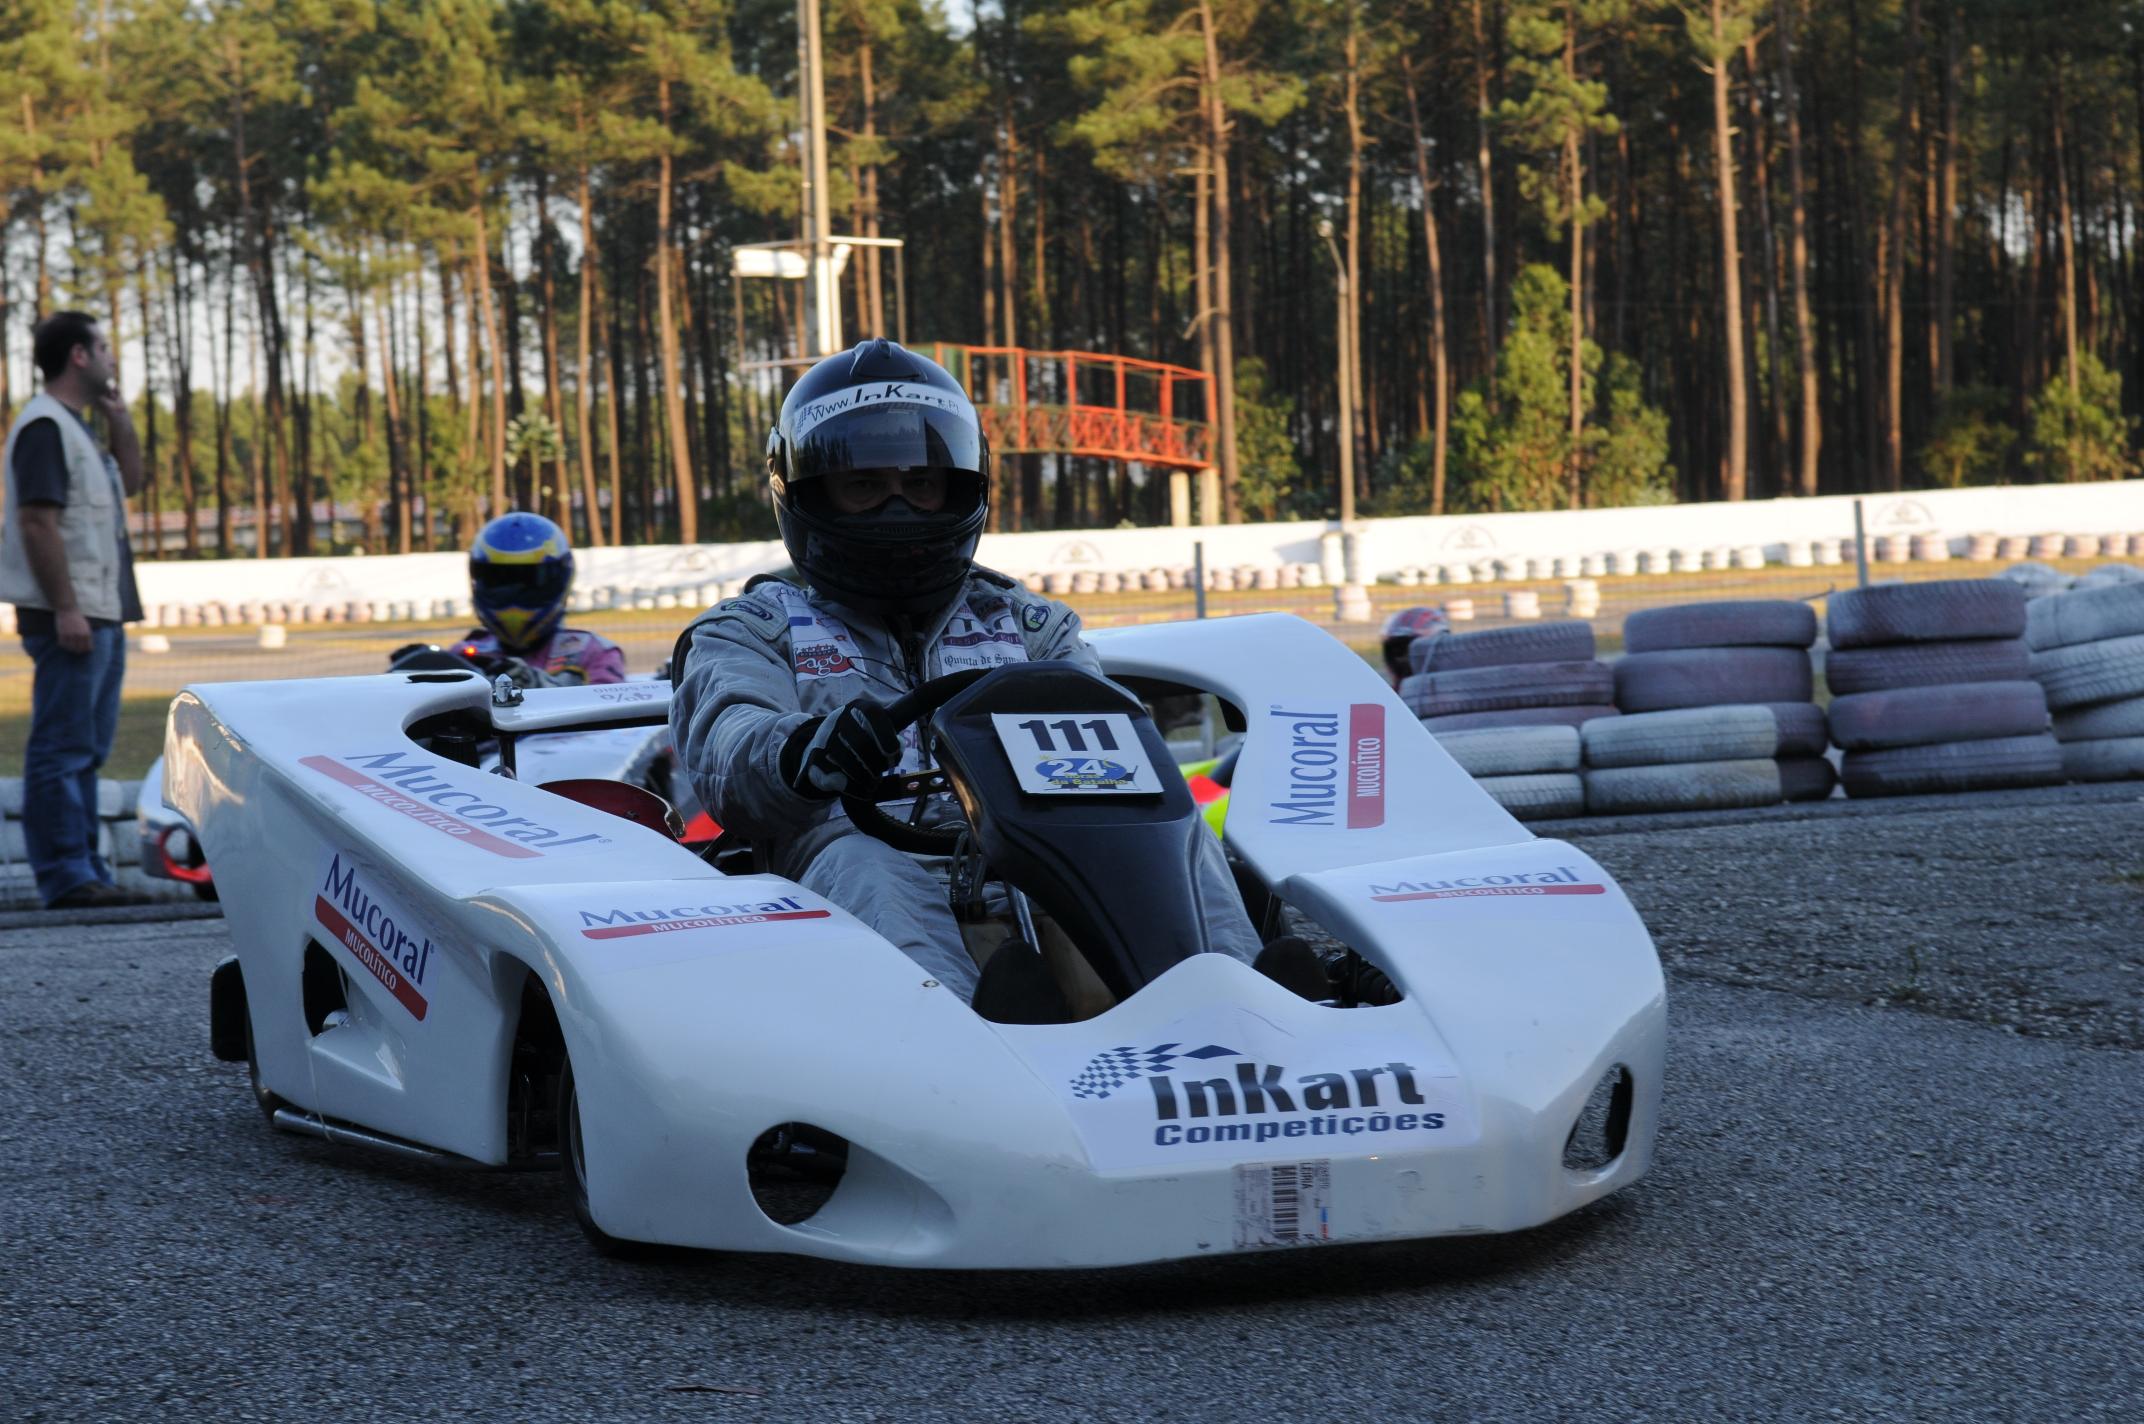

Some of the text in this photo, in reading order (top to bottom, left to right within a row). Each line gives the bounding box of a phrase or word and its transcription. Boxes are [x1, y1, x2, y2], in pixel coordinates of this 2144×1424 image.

[1018, 719, 1120, 751] 111
[1269, 711, 1339, 825] Mucoral
[1351, 738, 1380, 797] MUCOLÍTICO
[344, 752, 603, 848] Mucoral
[1368, 867, 1581, 894] Mucoral
[325, 853, 430, 986] Mucoral
[579, 896, 806, 926] Mucoral
[345, 928, 396, 989] MUCOLÍTICO
[1150, 1062, 1426, 1120] InKart
[1155, 1112, 1446, 1146] Competições
